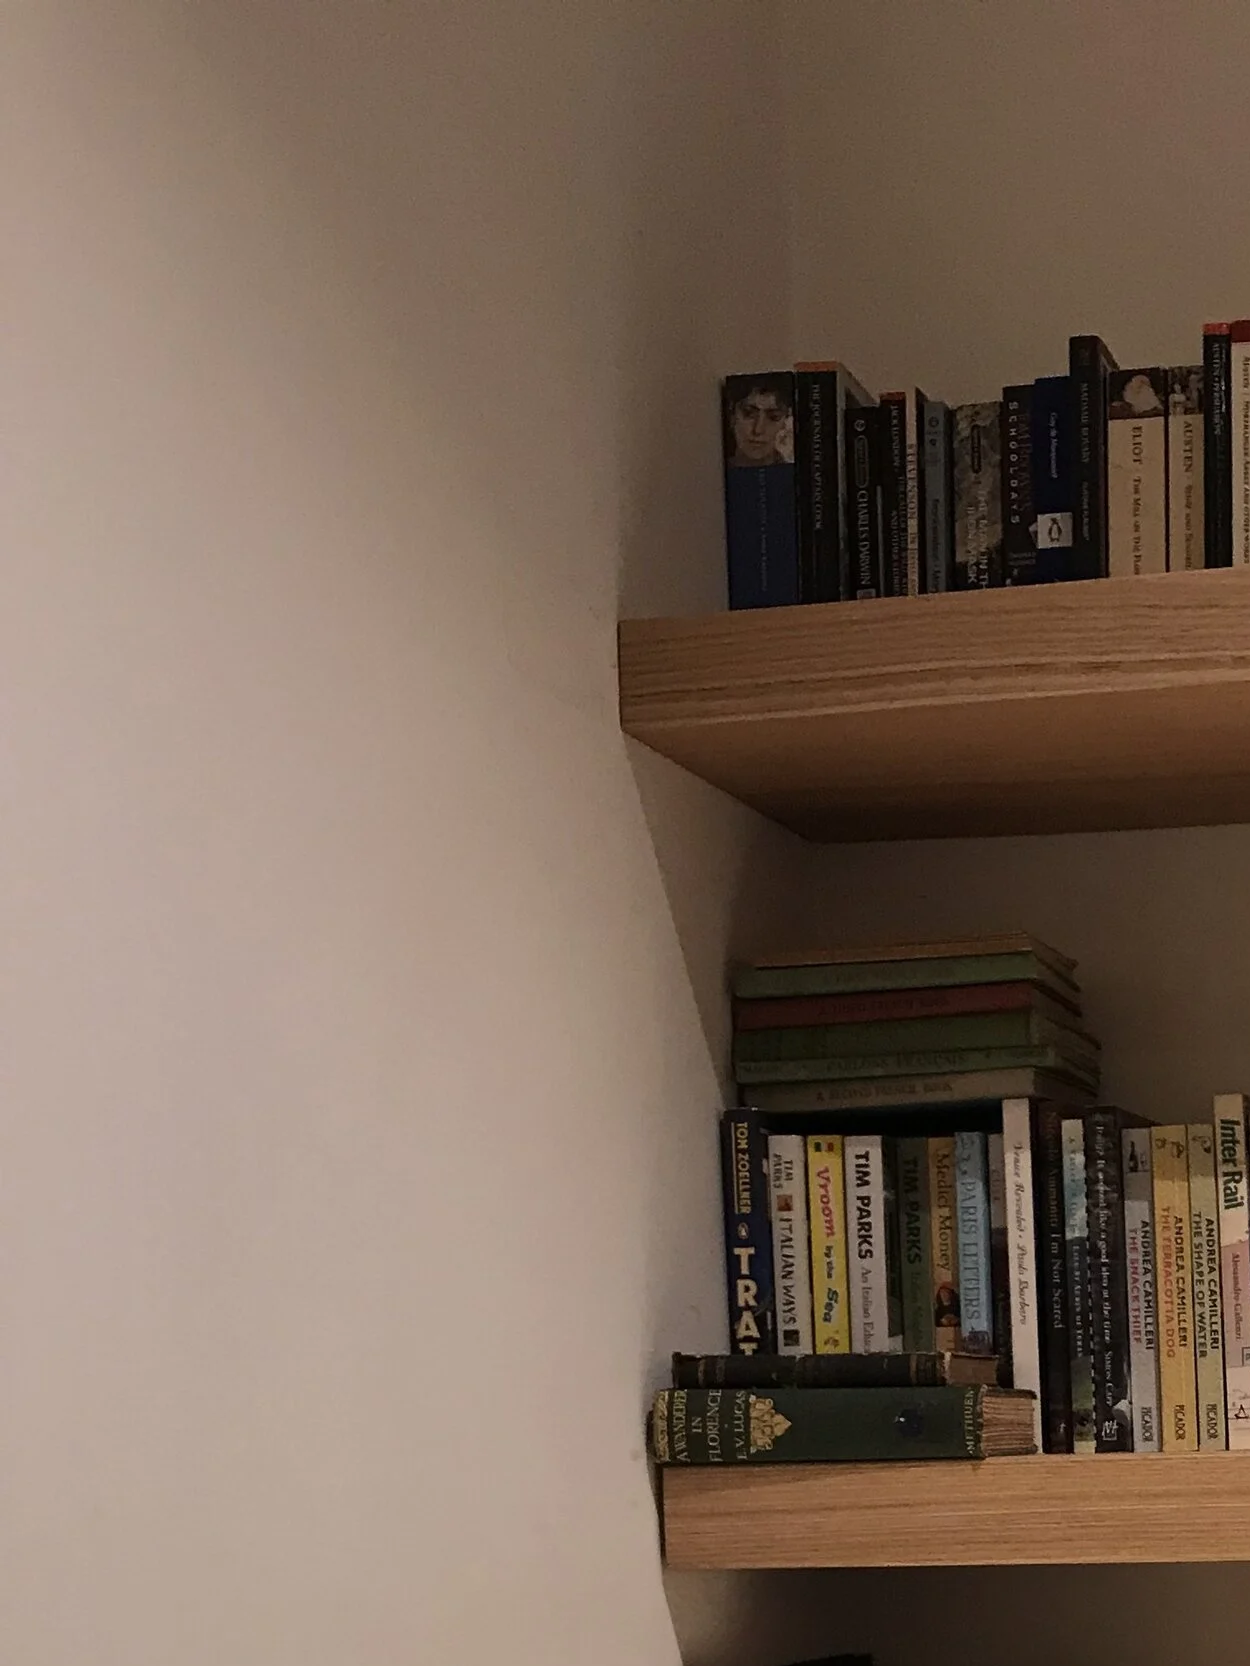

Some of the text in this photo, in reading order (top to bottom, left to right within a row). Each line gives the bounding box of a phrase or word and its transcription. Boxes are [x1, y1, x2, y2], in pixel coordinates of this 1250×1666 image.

[736, 1122, 752, 1214] TOM ZOELLNER
[816, 1167, 837, 1238] Vroom
[854, 1151, 873, 1259] TIM PARKS
[1219, 1119, 1244, 1210] Inter Rail
[779, 1218, 799, 1326] ITALIAN WAYS
[822, 1287, 840, 1324] Sea
